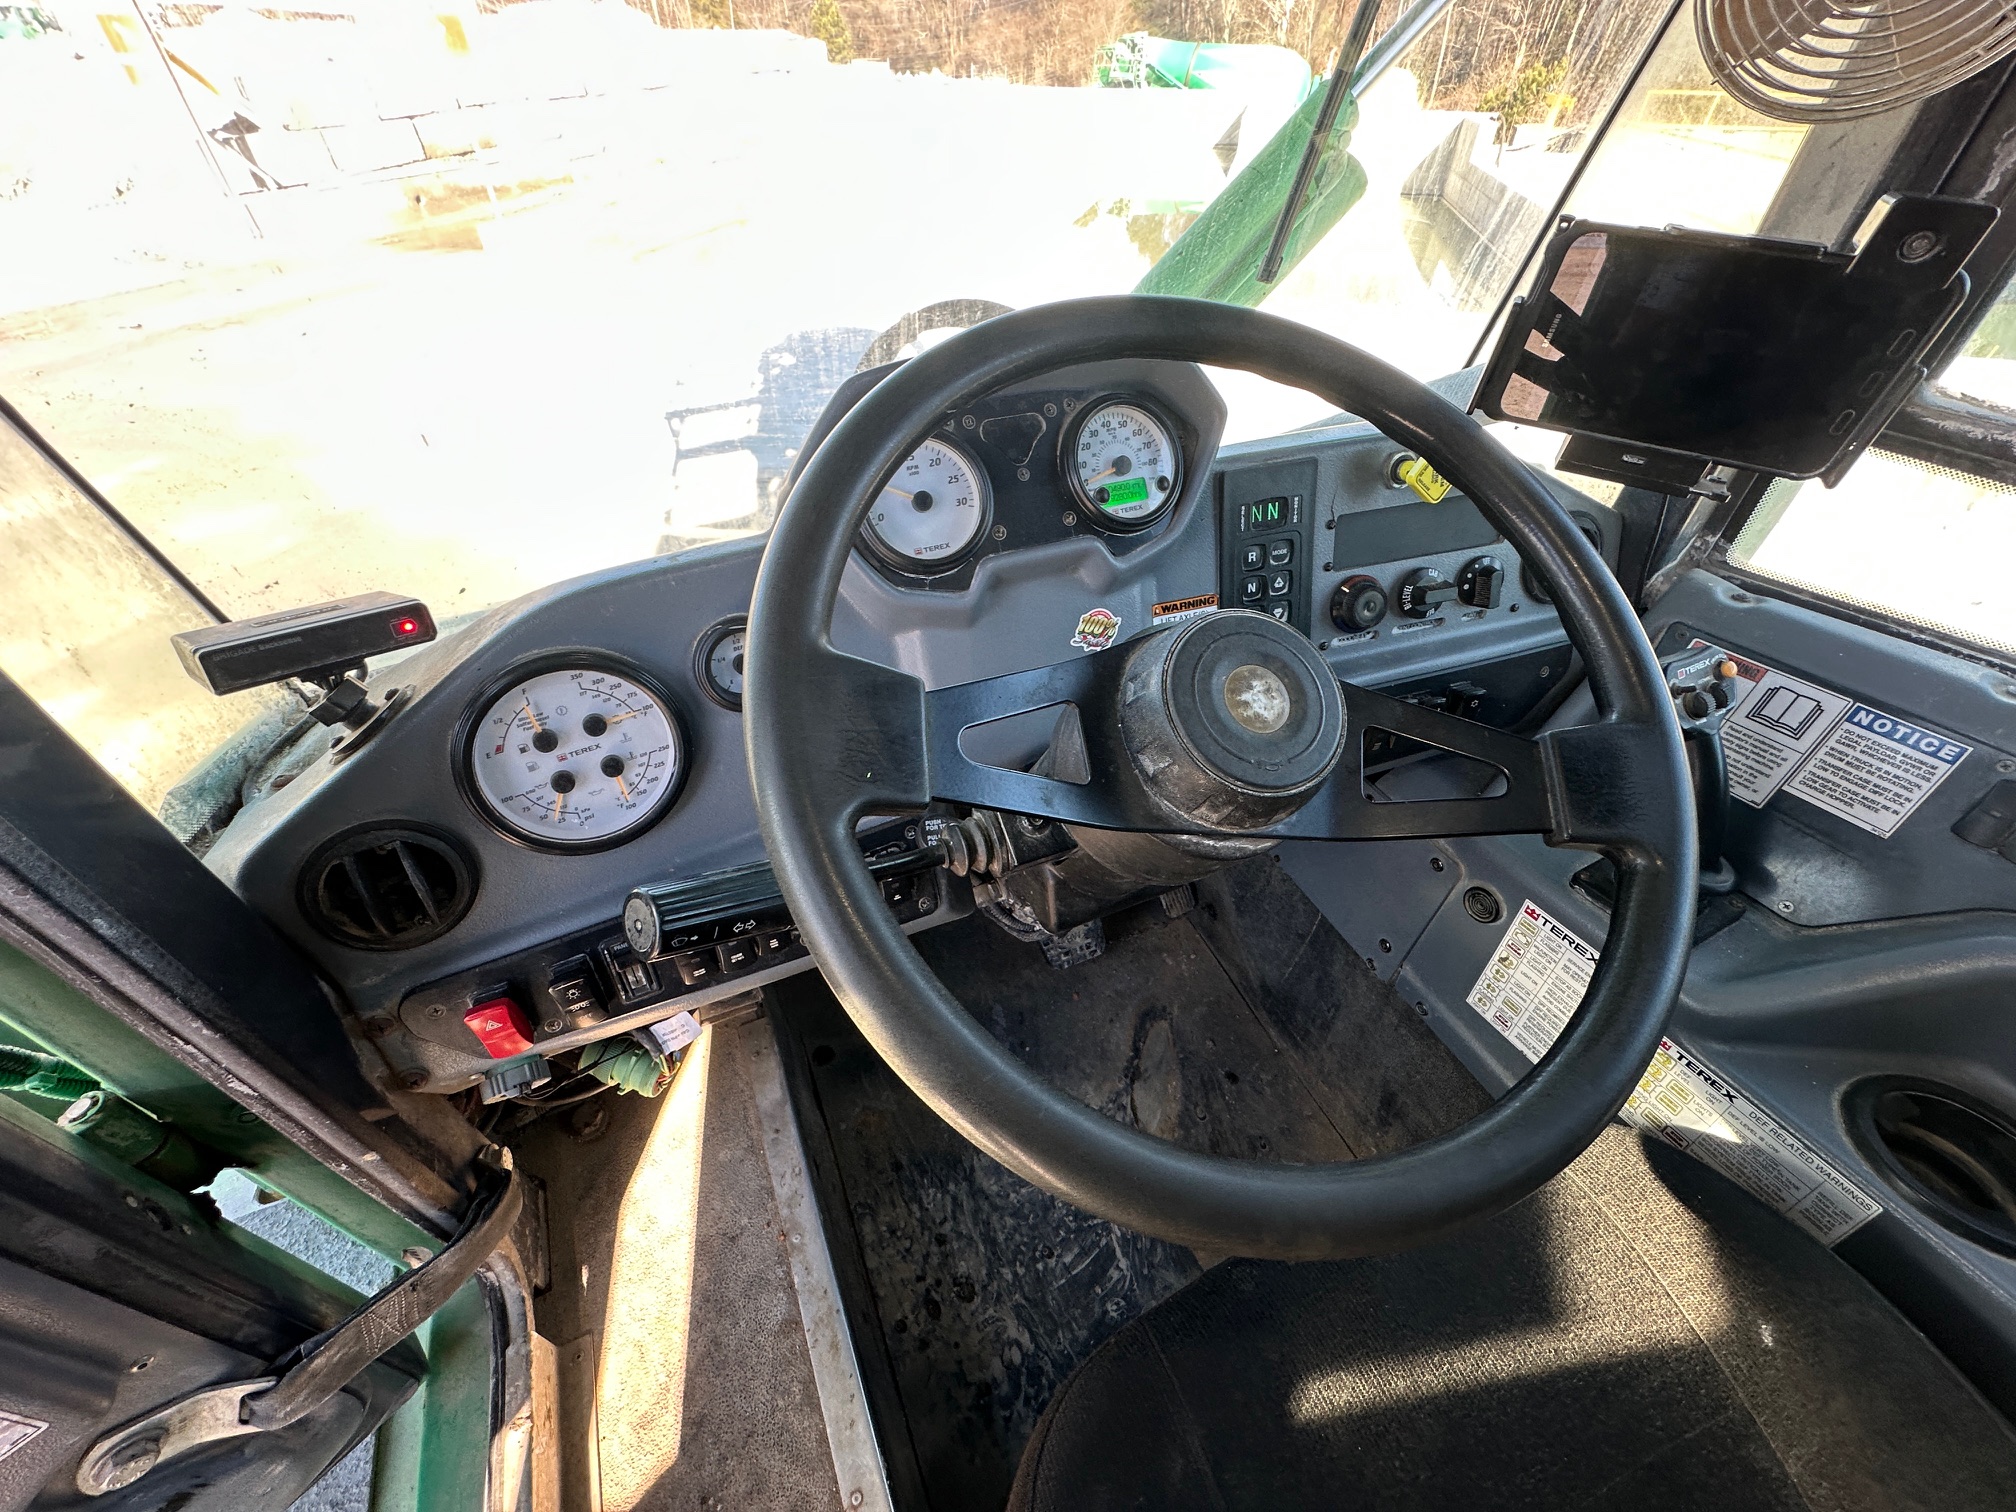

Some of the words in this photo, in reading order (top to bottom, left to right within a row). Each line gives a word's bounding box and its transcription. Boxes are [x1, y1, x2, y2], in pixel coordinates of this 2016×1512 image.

[1541, 313, 1562, 348] SAMSUNG
[1101, 420, 1111, 429] 40
[1117, 420, 1128, 429] 50
[1089, 429, 1099, 438] 30
[1132, 429, 1142, 437] 60
[1081, 442, 1091, 451] 20
[1142, 441, 1152, 450] 70
[929, 457, 941, 467] 20
[1148, 458, 1158, 466] 80
[948, 475, 959, 484] 25
[956, 497, 967, 506] 30
[1120, 504, 1143, 514] TEREX
[1252, 504, 1262, 522] N
[1268, 502, 1278, 520] N
[878, 513, 884, 522] 0
[923, 542, 951, 553] TEREX
[1248, 552, 1256, 562] R
[1428, 569, 1438, 577] CAB
[1247, 583, 1256, 593] N
[1161, 597, 1215, 613] WARNING
[1685, 658, 1712, 674] TEREX
[592, 678, 605, 686] 300
[609, 683, 622, 691] 250
[642, 703, 654, 711] 100
[1851, 709, 1960, 761] NOTICE
[568, 743, 602, 757] TEREX
[658, 744, 670, 752] 250
[1843, 728, 1856, 736] DO
[1854, 733, 1871, 743] NOT
[1870, 740, 1901, 755] EXCEED
[1900, 752, 1938, 770] MAXIMUM
[1827, 745, 1850, 758] WHEN
[1849, 755, 1876, 769] TRUCK
[1838, 733, 1863, 746] LEGAL
[1922, 768, 1936, 777] OR
[1823, 750, 1845, 762] DRUM
[1843, 760, 1865, 772] MUST
[1875, 773, 1915, 793] ROTATING.
[1858, 748, 1902, 770] WHICHEVER
[1909, 770, 1933, 783] LESS.
[647, 776, 659, 784] 200
[1812, 763, 1829, 773] LOW
[1838, 774, 1869, 790] ENGAGE
[1867, 787, 1885, 798] DIFF
[1816, 758, 1853, 776] TRANSFER
[1851, 773, 1873, 785] CASE
[1871, 782, 1893, 794] MUST
[1891, 791, 1904, 799] BE
[1797, 779, 1826, 795] CHARGE
[1825, 792, 1856, 809] HOPPER.
[1801, 775, 1818, 785] LOW
[1817, 782, 1838, 794] GEAR
[1846, 795, 1881, 813] ACTIVATE
[1805, 770, 1842, 789] TRANSFER
[1840, 786, 1861, 797] CASE
[1860, 794, 1882, 806] MUST
[1880, 803, 1892, 811] BE
[501, 795, 514, 803] 100
[1537, 914, 1599, 965] TEREX
[1543, 933, 1555, 944] LIGHT
[1539, 938, 1559, 955] FLASHING
[1533, 948, 1545, 960] LIGHT
[1529, 955, 1542, 967] LIGHT
[1566, 957, 1585, 973] SERVICE
[1525, 960, 1545, 977] FLASHING
[1520, 969, 1532, 981] LIGHT
[1554, 975, 1566, 986] STOP
[1513, 980, 1525, 992] LIGHT
[1524, 989, 1531, 997] ON
[1508, 986, 1527, 1004] FLASHING
[1672, 1070, 1690, 1085] LEVEL
[1679, 1069, 1692, 1080] DEF
[1704, 1089, 1723, 1104] LIGHT
[1704, 1096, 1715, 1105] ON
[1691, 1099, 1713, 1117] LIGHTS
[1694, 1106, 1705, 1116] ON
[1673, 1050, 1738, 1104] TEREX
[1748, 1110, 1770, 1129] DEF
[1767, 1126, 1816, 1164] RELATED
[1812, 1163, 1874, 1211] WARNINGS
[1738, 1120, 1759, 1137] LEVEL
